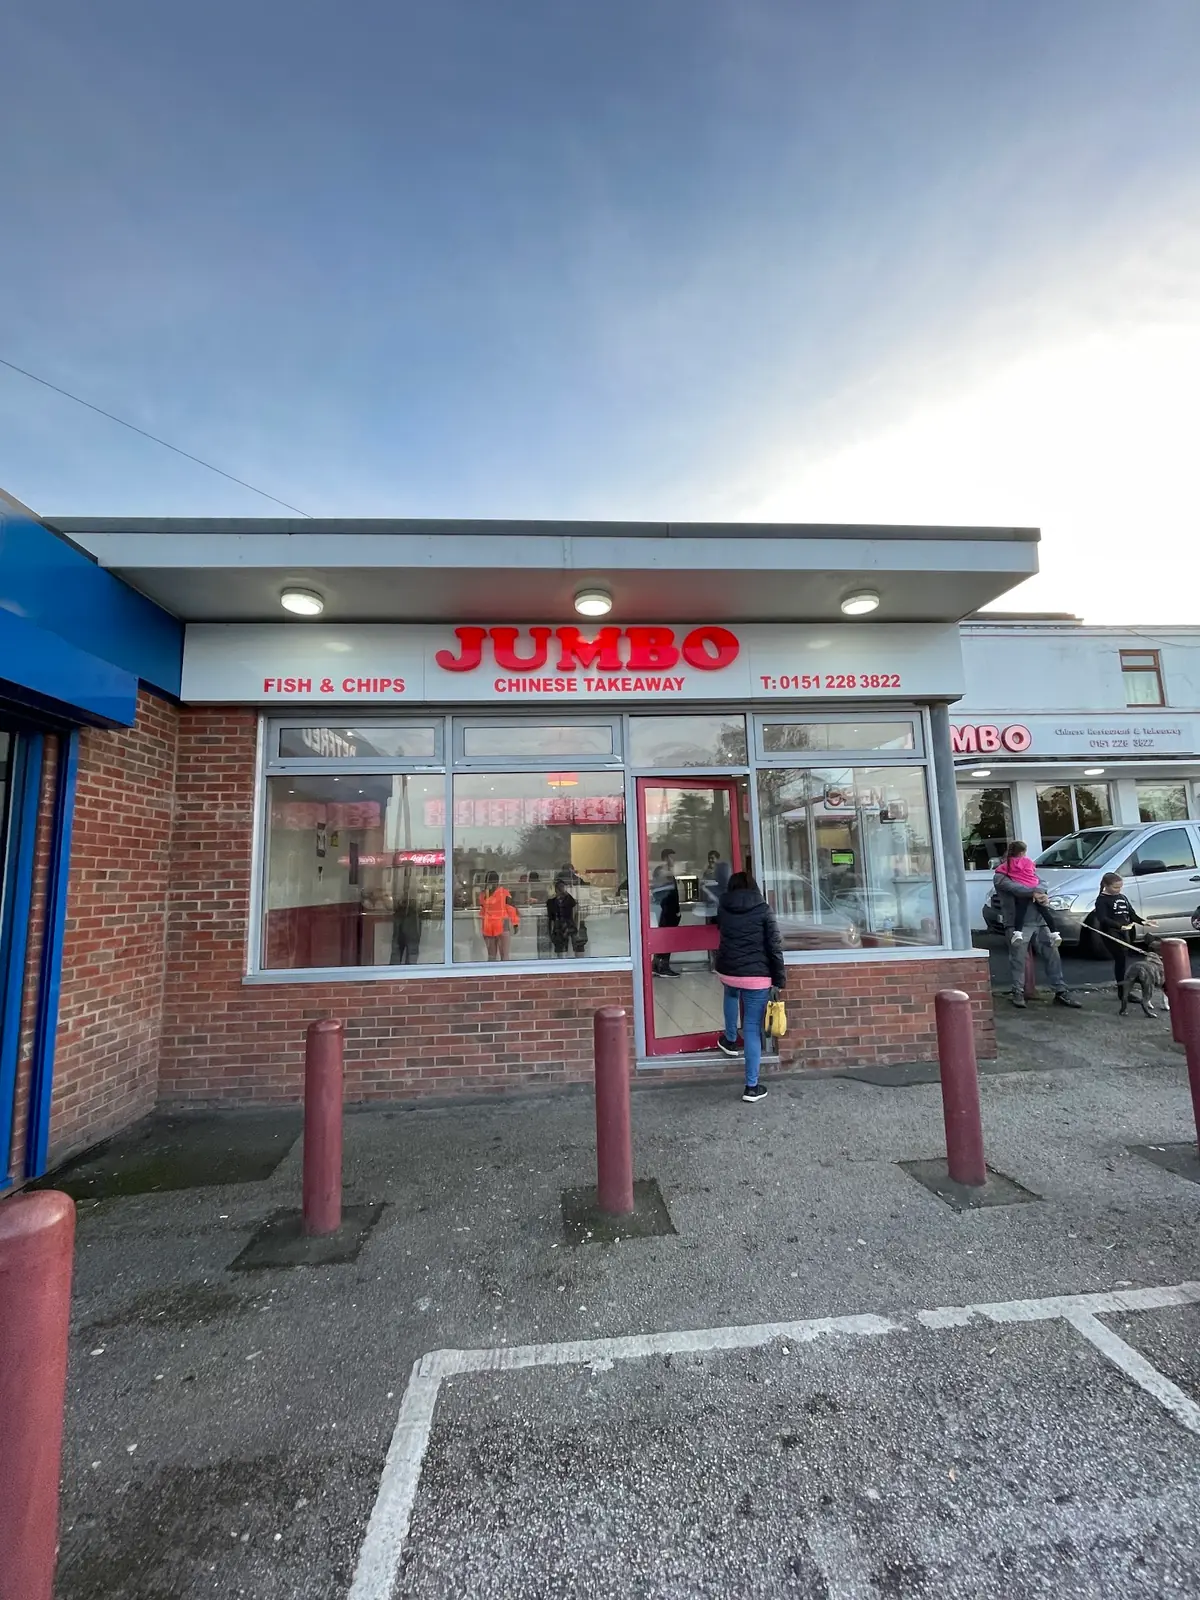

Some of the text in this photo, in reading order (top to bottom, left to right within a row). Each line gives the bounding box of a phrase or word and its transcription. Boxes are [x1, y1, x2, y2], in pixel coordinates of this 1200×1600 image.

[434, 625, 740, 672] JUMBO
[263, 678, 406, 693] FISH & CHIPS
[494, 676, 685, 692] CHINESE TAKEAWAY
[779, 675, 821, 690] 0151
[825, 674, 857, 689] 228
[859, 674, 901, 688] 3822
